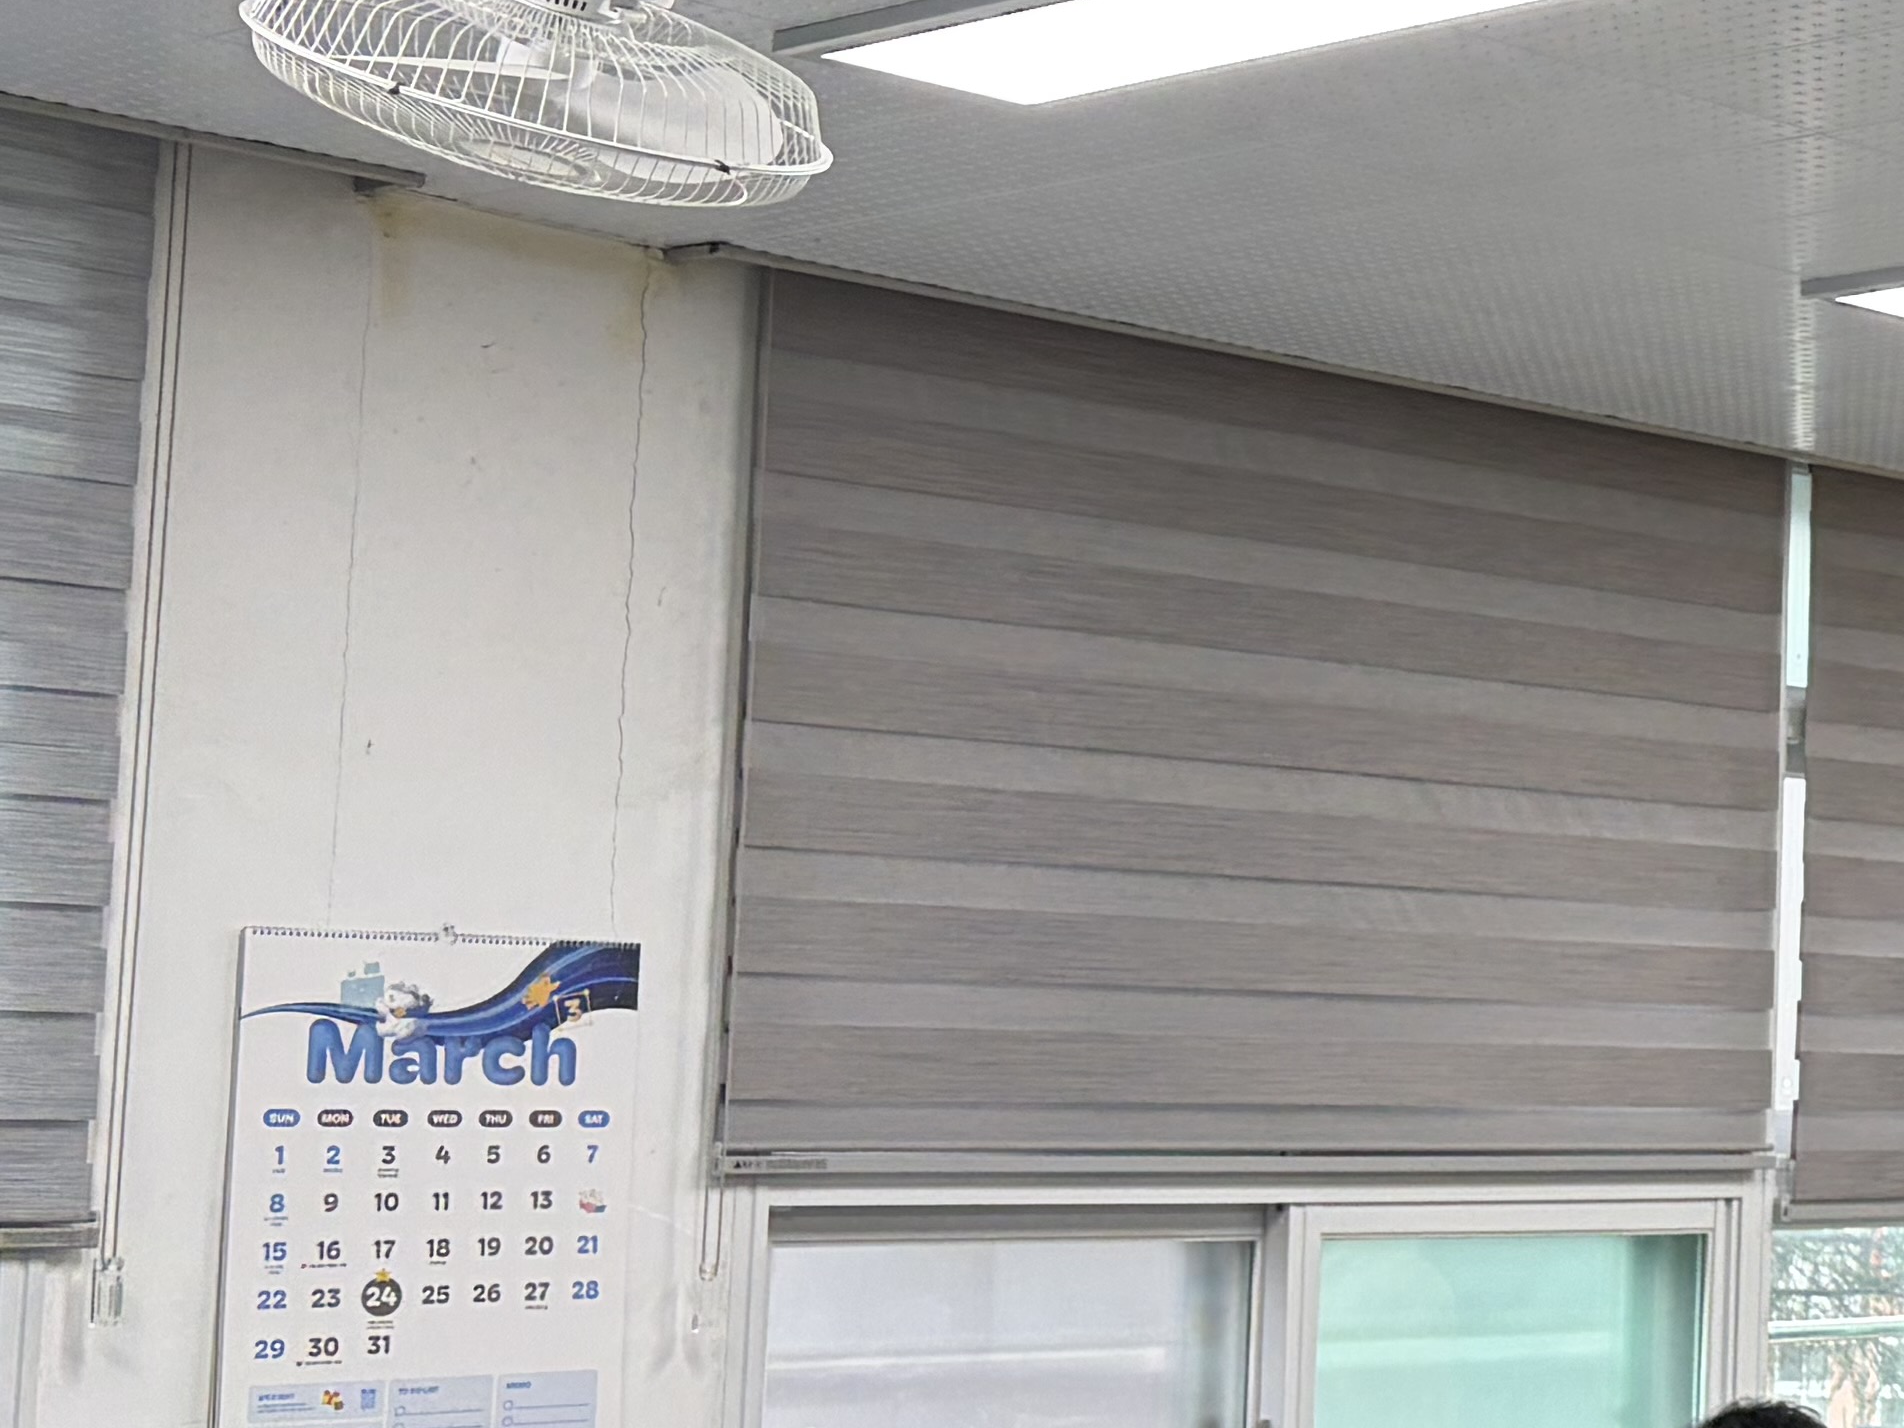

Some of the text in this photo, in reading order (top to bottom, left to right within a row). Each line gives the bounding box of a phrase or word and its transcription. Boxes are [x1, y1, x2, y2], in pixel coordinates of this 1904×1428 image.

[306, 1018, 576, 1086] March
[269, 1113, 295, 1123] SUN
[322, 1113, 350, 1123] MON
[380, 1114, 401, 1123] TUE
[432, 1114, 458, 1124] WED
[485, 1114, 507, 1124] THU
[275, 1145, 599, 1165] 1 2 3 4 5 6 7
[269, 1190, 553, 1213] 8 9 10 11 12 13
[262, 1235, 598, 1261] 15 16 17 18 19 20 21
[257, 1280, 599, 1310] 22 23 24 25 26 27 28
[254, 1335, 390, 1359] 29 30 31
